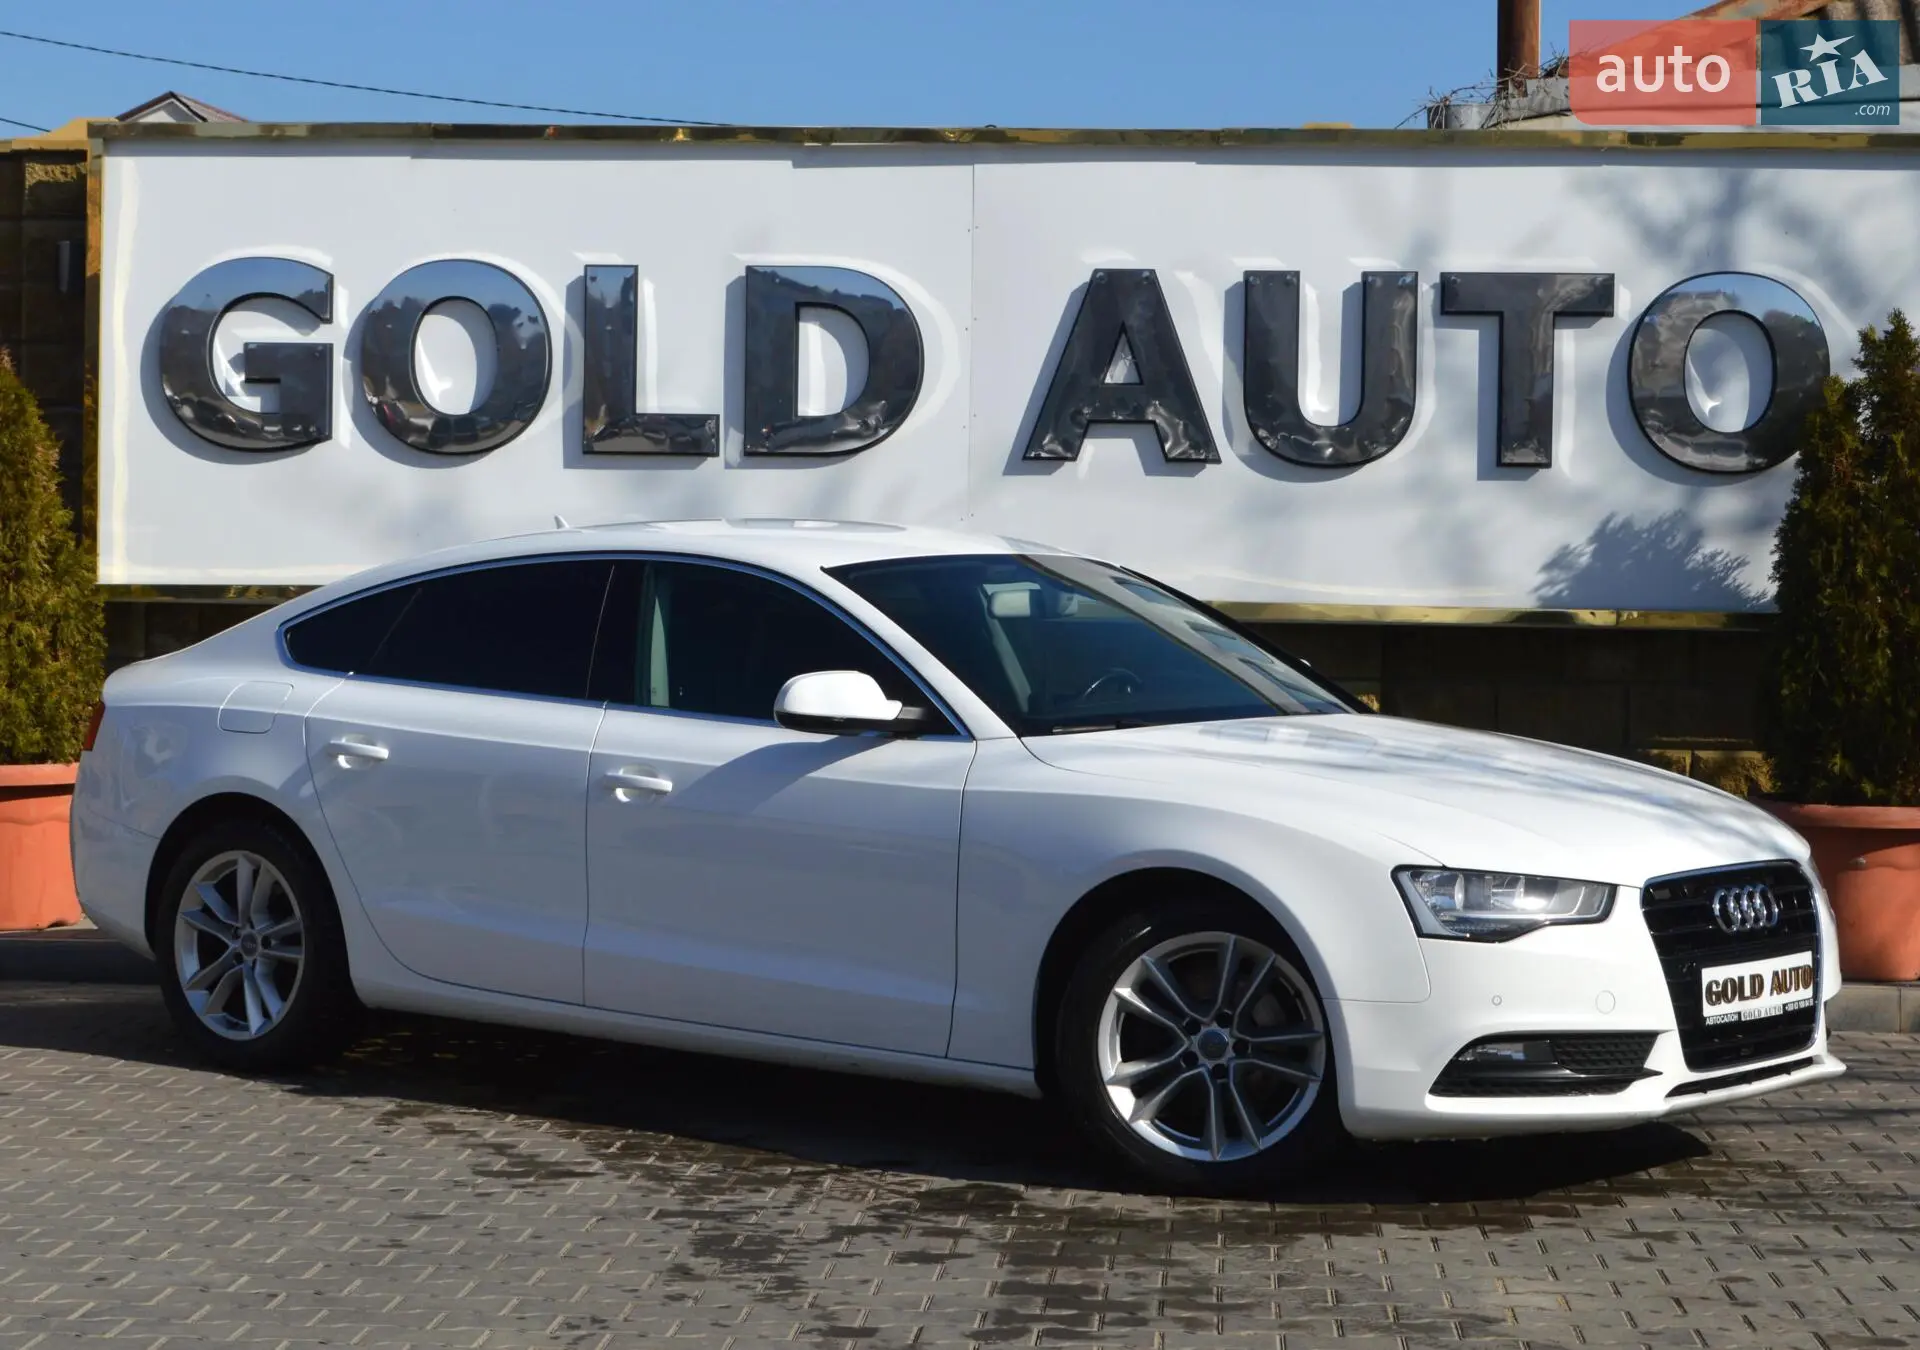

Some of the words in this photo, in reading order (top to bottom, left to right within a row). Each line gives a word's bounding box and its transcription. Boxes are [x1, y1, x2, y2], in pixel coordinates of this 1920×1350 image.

[158, 256, 926, 458] GOLD
[1022, 268, 1831, 474] AUTO
[1705, 973, 1764, 1007] GOLD
[1770, 964, 1813, 997] AUTO
[1743, 1009, 1762, 1020] GOLD
[1764, 1006, 1781, 1017] AUTO
